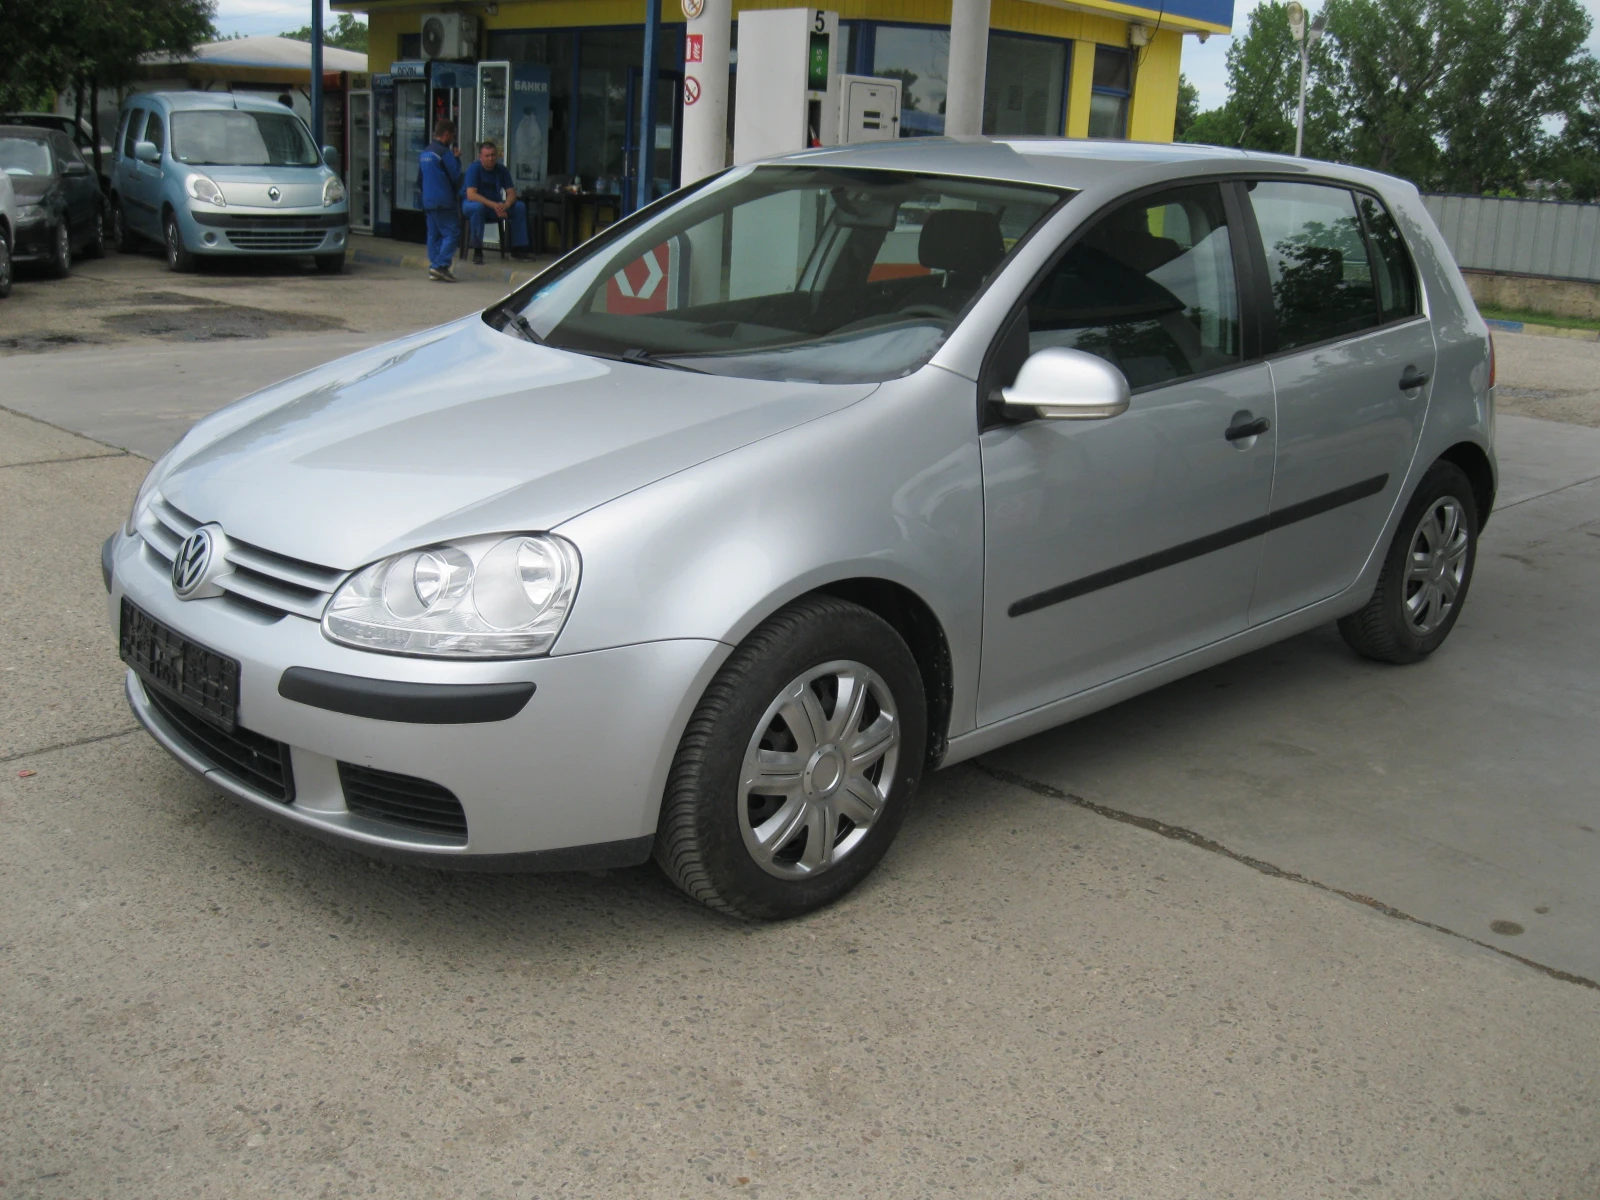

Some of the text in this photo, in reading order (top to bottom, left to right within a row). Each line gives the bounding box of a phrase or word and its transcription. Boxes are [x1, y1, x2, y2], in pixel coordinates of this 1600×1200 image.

[815, 9, 825, 33] 5
[816, 49, 823, 61] 95
[514, 80, 548, 93] БАНКЯ
[173, 529, 211, 597] VW
